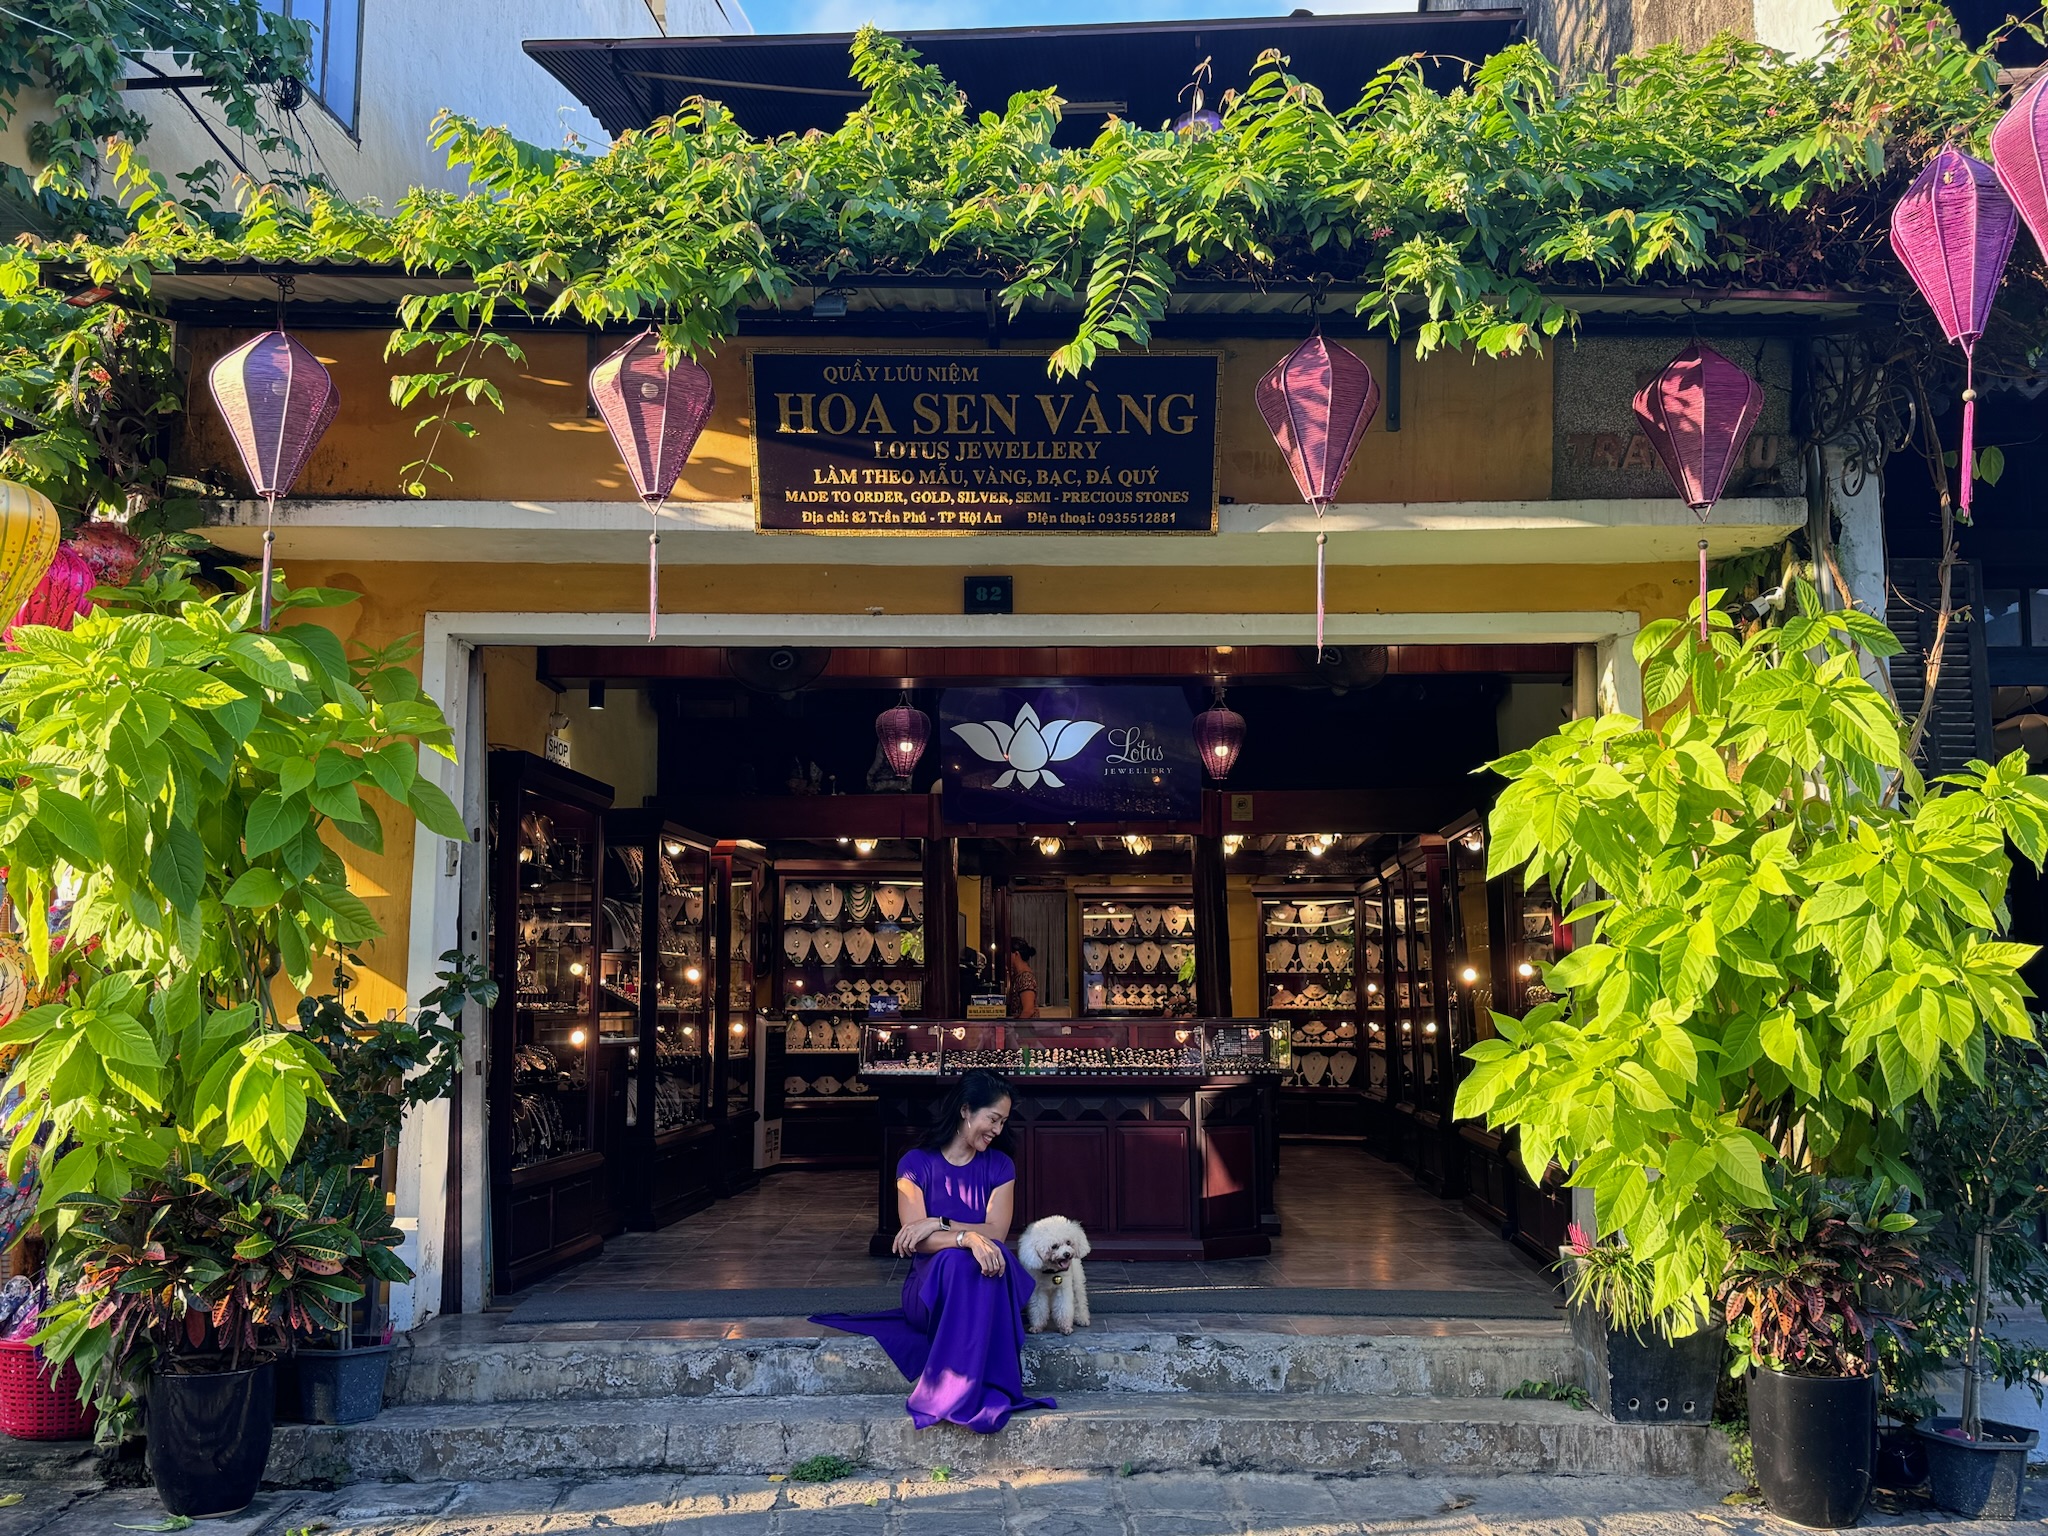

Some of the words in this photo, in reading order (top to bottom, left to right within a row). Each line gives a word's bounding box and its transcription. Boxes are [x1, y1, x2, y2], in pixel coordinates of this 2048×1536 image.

[823, 359, 879, 383] QUẦY
[884, 364, 924, 382] LƯU
[927, 362, 979, 384] NIỆM
[774, 392, 896, 435] HOA
[913, 392, 1020, 435] SEN
[1034, 380, 1198, 435] VÀNG
[873, 440, 950, 461] LOTUS
[954, 440, 1102, 462] JEWELLERY
[1566, 433, 1664, 470] TRA
[813, 466, 857, 485] LÀM
[862, 469, 915, 485] THEO
[918, 462, 968, 487] MẪU,
[973, 465, 1033, 487] VÀNG,
[1036, 469, 1082, 488] BẠC,
[1086, 465, 1113, 485] ĐÁ
[1118, 465, 1160, 487] QUÝ
[785, 490, 829, 503] MADE
[831, 491, 851, 503] TO
[853, 491, 908, 506] ORDER,
[911, 491, 955, 506] GOLD,
[957, 491, 1014, 506] SILVER,
[1015, 491, 1051, 504] SEMI
[1062, 491, 1132, 503] PRECIOUS
[1135, 491, 1190, 503] STONES
[801, 511, 824, 526] Địa
[826, 510, 849, 524] chỉ:
[851, 511, 867, 524] 82
[868, 508, 901, 524] Trần
[902, 510, 927, 524] Phú
[938, 511, 957, 524] TP
[958, 511, 982, 526] Hội
[983, 511, 1002, 524] An
[1027, 511, 1057, 526] Điện
[1060, 511, 1095, 526] thoại:
[1098, 512, 1176, 524] 0935512881
[976, 586, 1002, 601] 82
[548, 739, 568, 757] SHOP
[1106, 726, 1164, 764] Lotus
[1104, 767, 1173, 776] JEWELLERY
